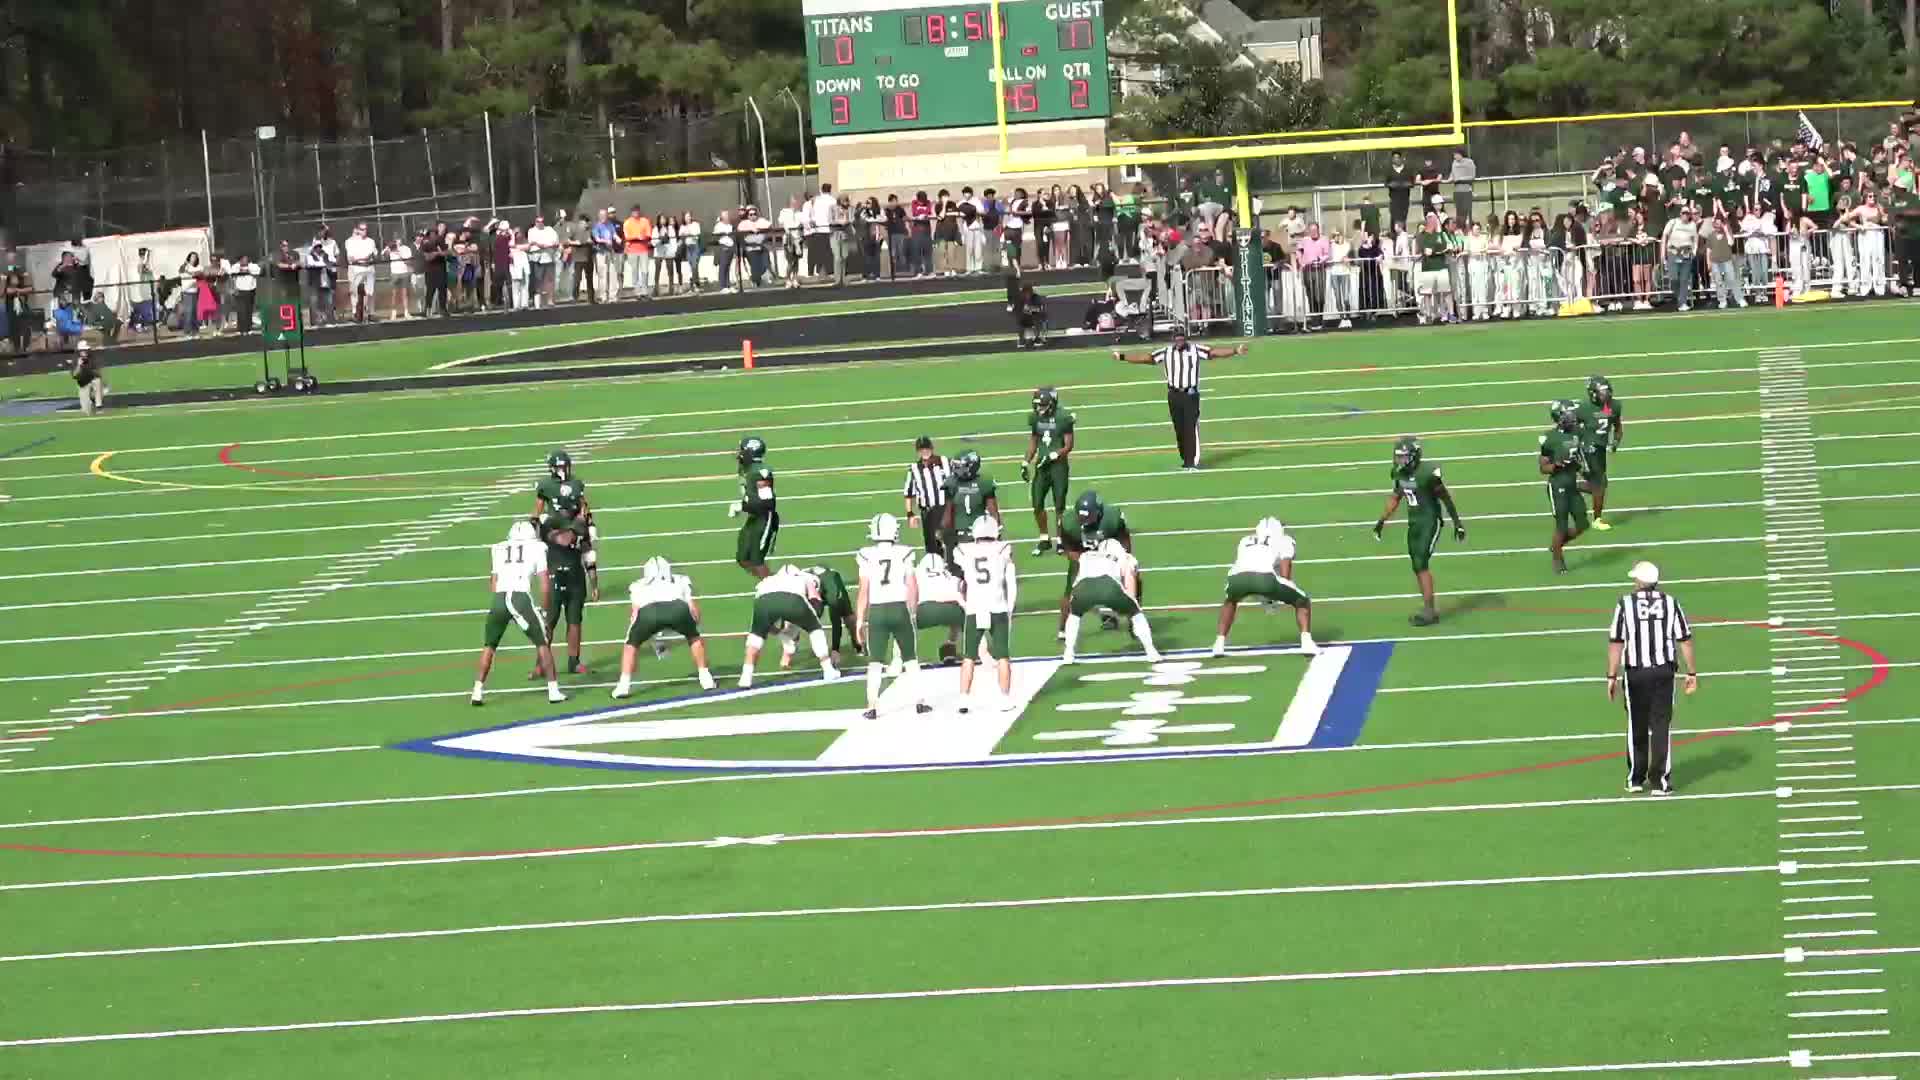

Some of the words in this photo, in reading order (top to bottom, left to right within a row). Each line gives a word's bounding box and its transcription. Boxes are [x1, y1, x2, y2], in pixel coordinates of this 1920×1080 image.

[1045, 1, 1103, 20] GUEST
[811, 16, 873, 36] TITANS
[835, 35, 853, 65] 0
[876, 75, 896, 89] TO
[899, 74, 920, 88] GO
[1025, 64, 1047, 80] ON
[1063, 62, 1091, 81] QTR
[816, 78, 861, 94] DOWN
[1071, 80, 1089, 109] 2
[832, 96, 849, 124] 3
[1239, 247, 1255, 337] TITANS
[279, 304, 296, 331] 9
[1595, 418, 1609, 435] 2
[964, 494, 971, 515] 1
[504, 544, 524, 564] 11
[878, 559, 892, 586] 7
[974, 556, 991, 585] 5
[1637, 599, 1665, 620] 64
